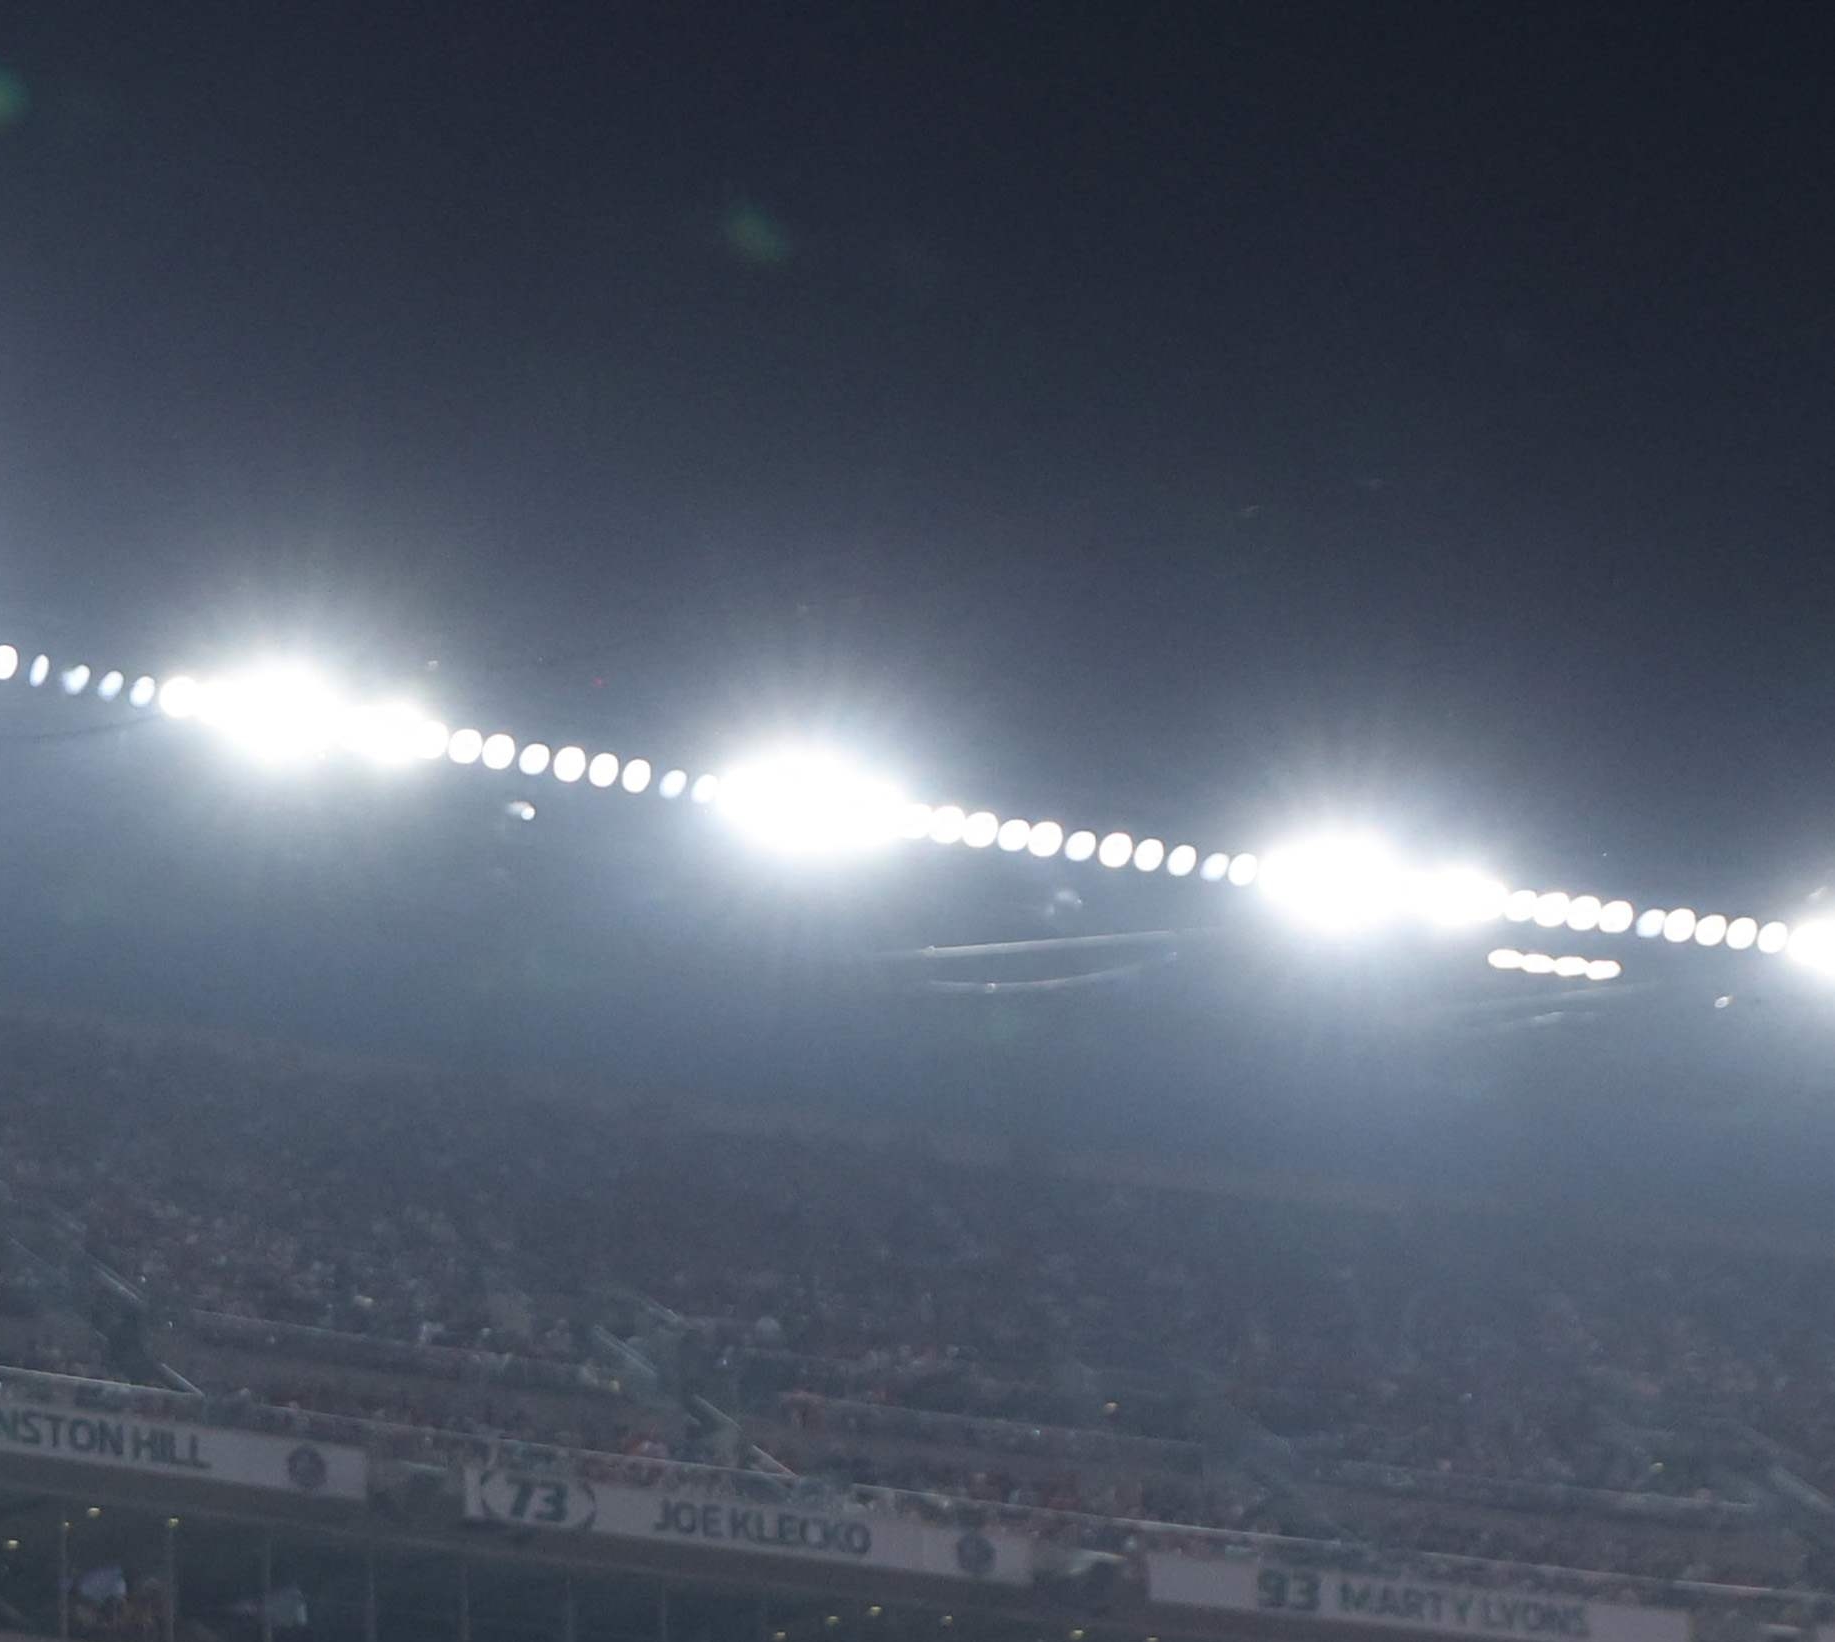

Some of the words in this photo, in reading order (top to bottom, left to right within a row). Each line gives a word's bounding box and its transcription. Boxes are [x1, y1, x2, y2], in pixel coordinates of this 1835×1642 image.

[133, 1427, 210, 1469] HILL
[503, 1476, 570, 1523] 73
[654, 1502, 723, 1538] JOE
[731, 1504, 872, 1555] KLECKO
